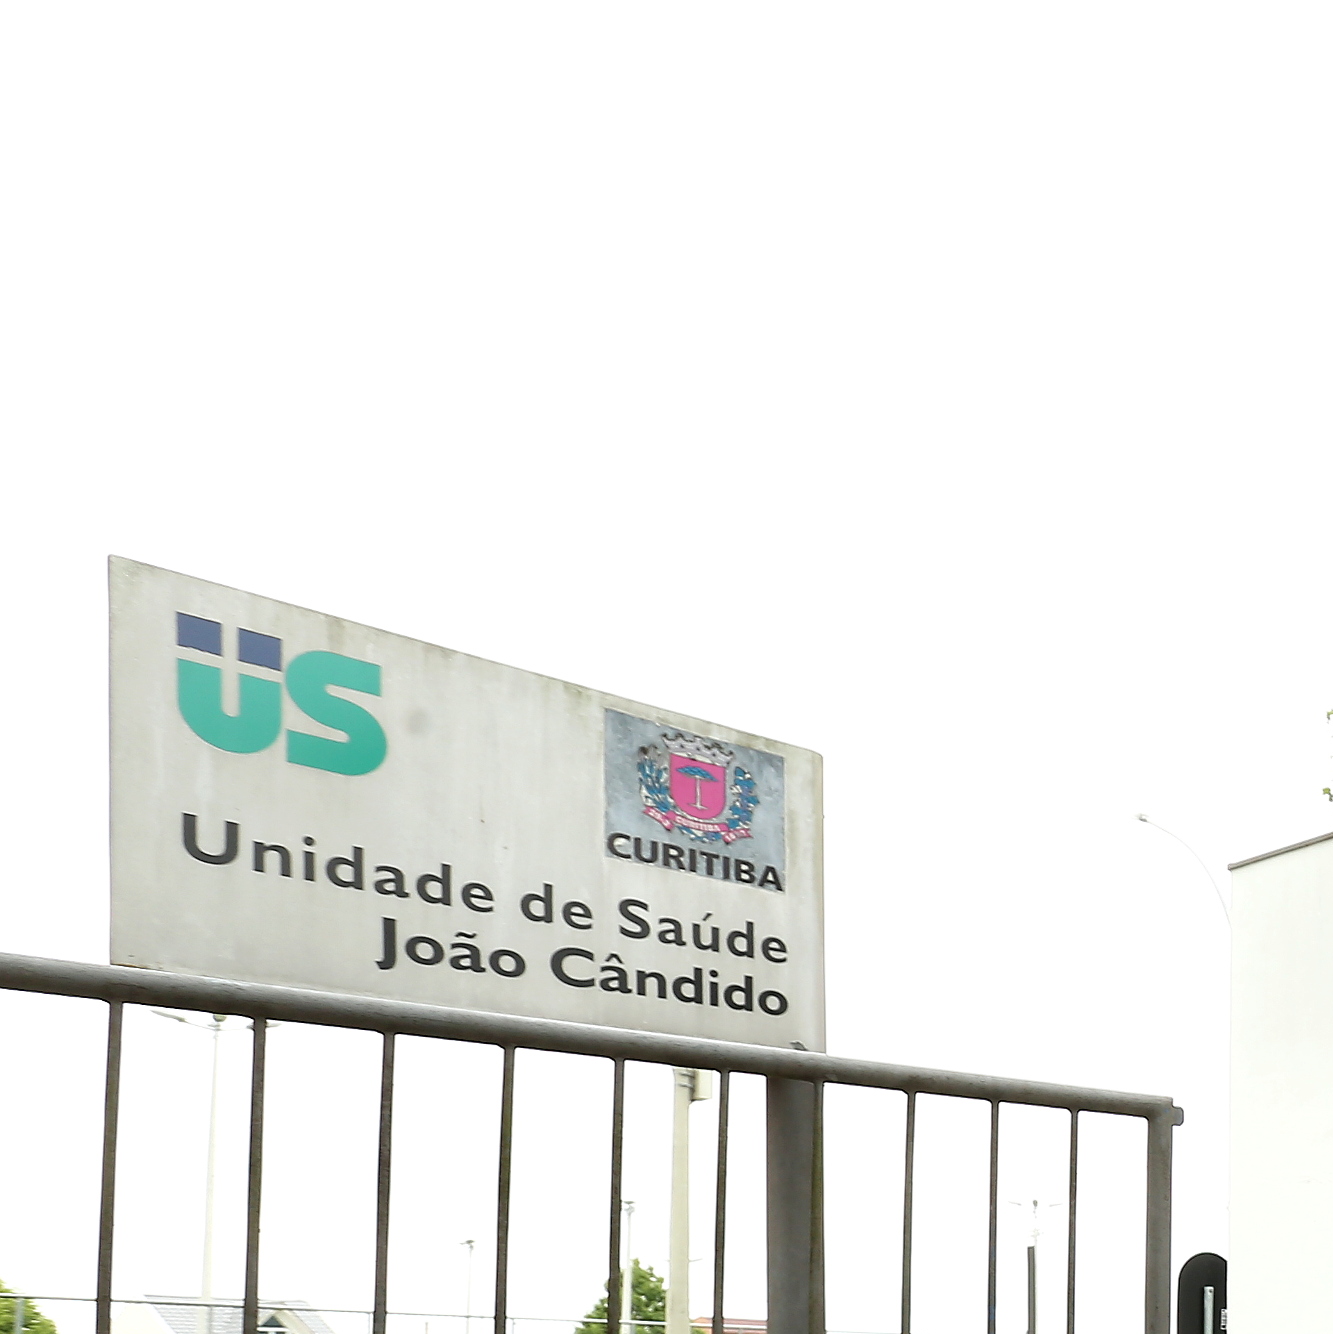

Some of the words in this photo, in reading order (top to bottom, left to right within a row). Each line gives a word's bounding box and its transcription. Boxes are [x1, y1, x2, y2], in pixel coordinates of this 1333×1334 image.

[180, 812, 495, 913] Unidade
[519, 883, 593, 930] de
[618, 897, 788, 964] Saúde
[606, 832, 785, 892] CURITIBA
[376, 917, 527, 978] João
[550, 947, 788, 1016] Cândido
